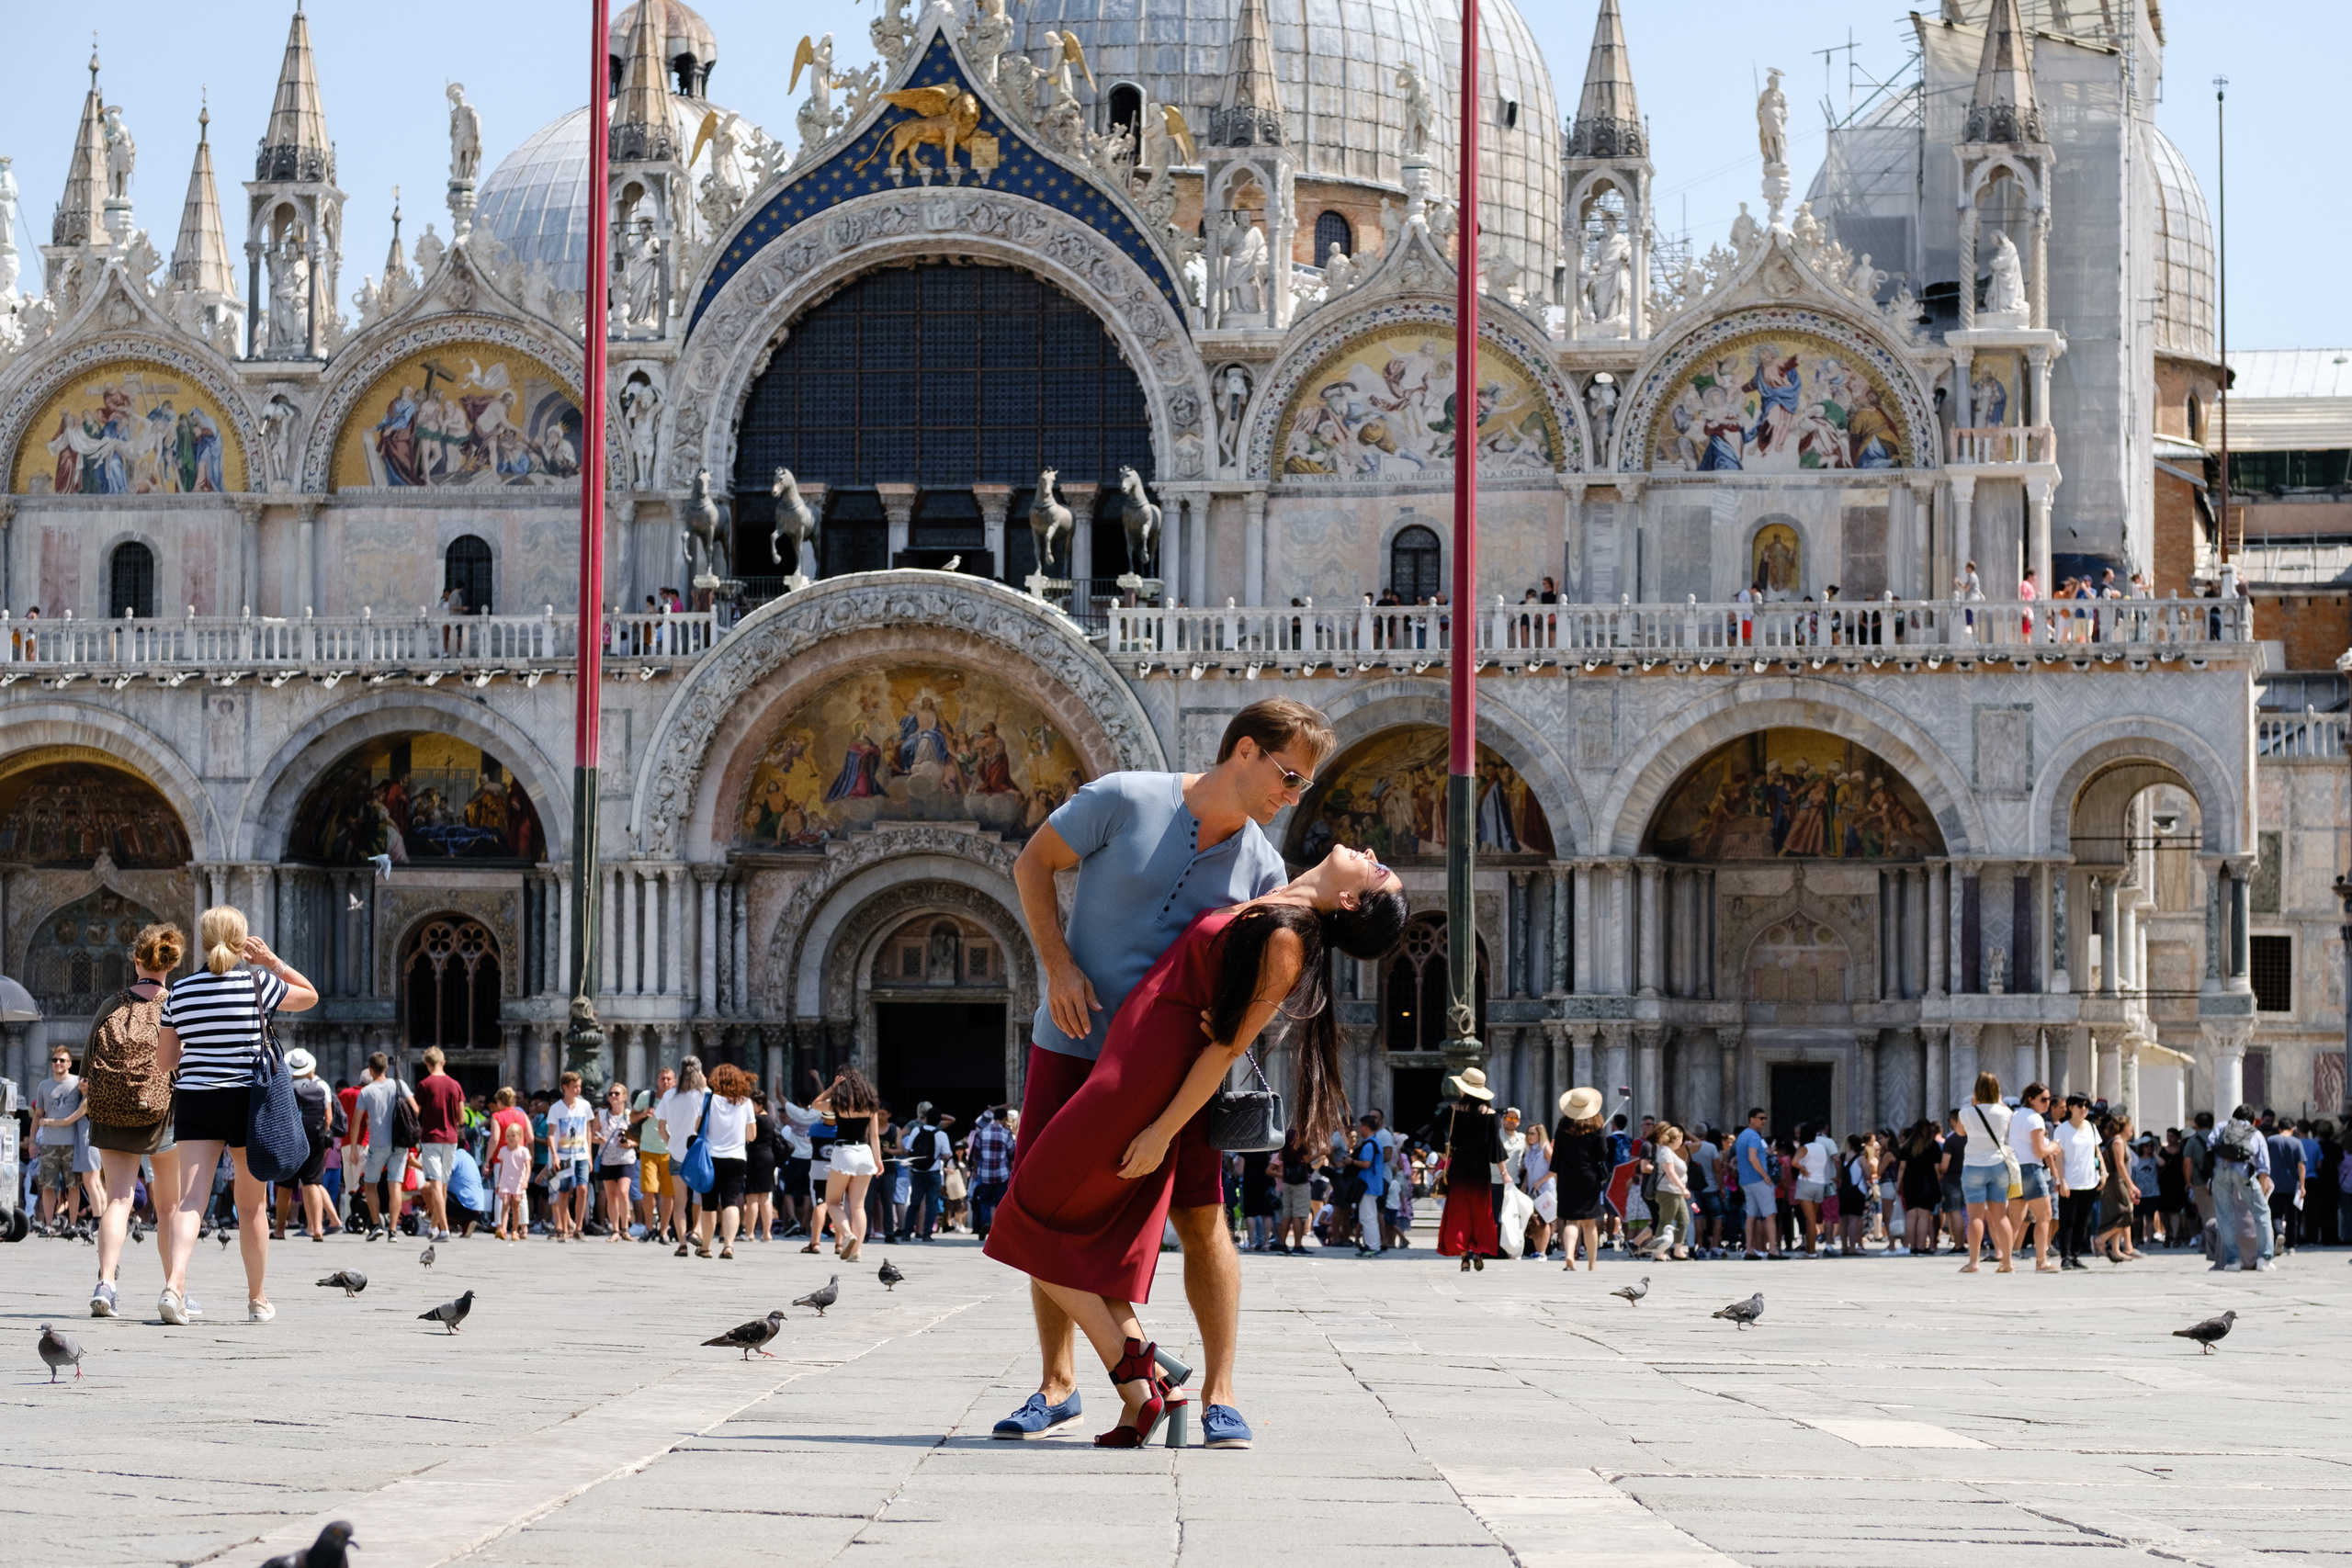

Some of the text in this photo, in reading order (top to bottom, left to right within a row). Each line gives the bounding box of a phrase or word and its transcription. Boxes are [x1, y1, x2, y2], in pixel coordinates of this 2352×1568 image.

[1290, 474, 1303, 483] EN
[1311, 474, 1341, 483] VERVS
[1349, 473, 1378, 482] FORTIS
[1385, 473, 1404, 482] QVI
